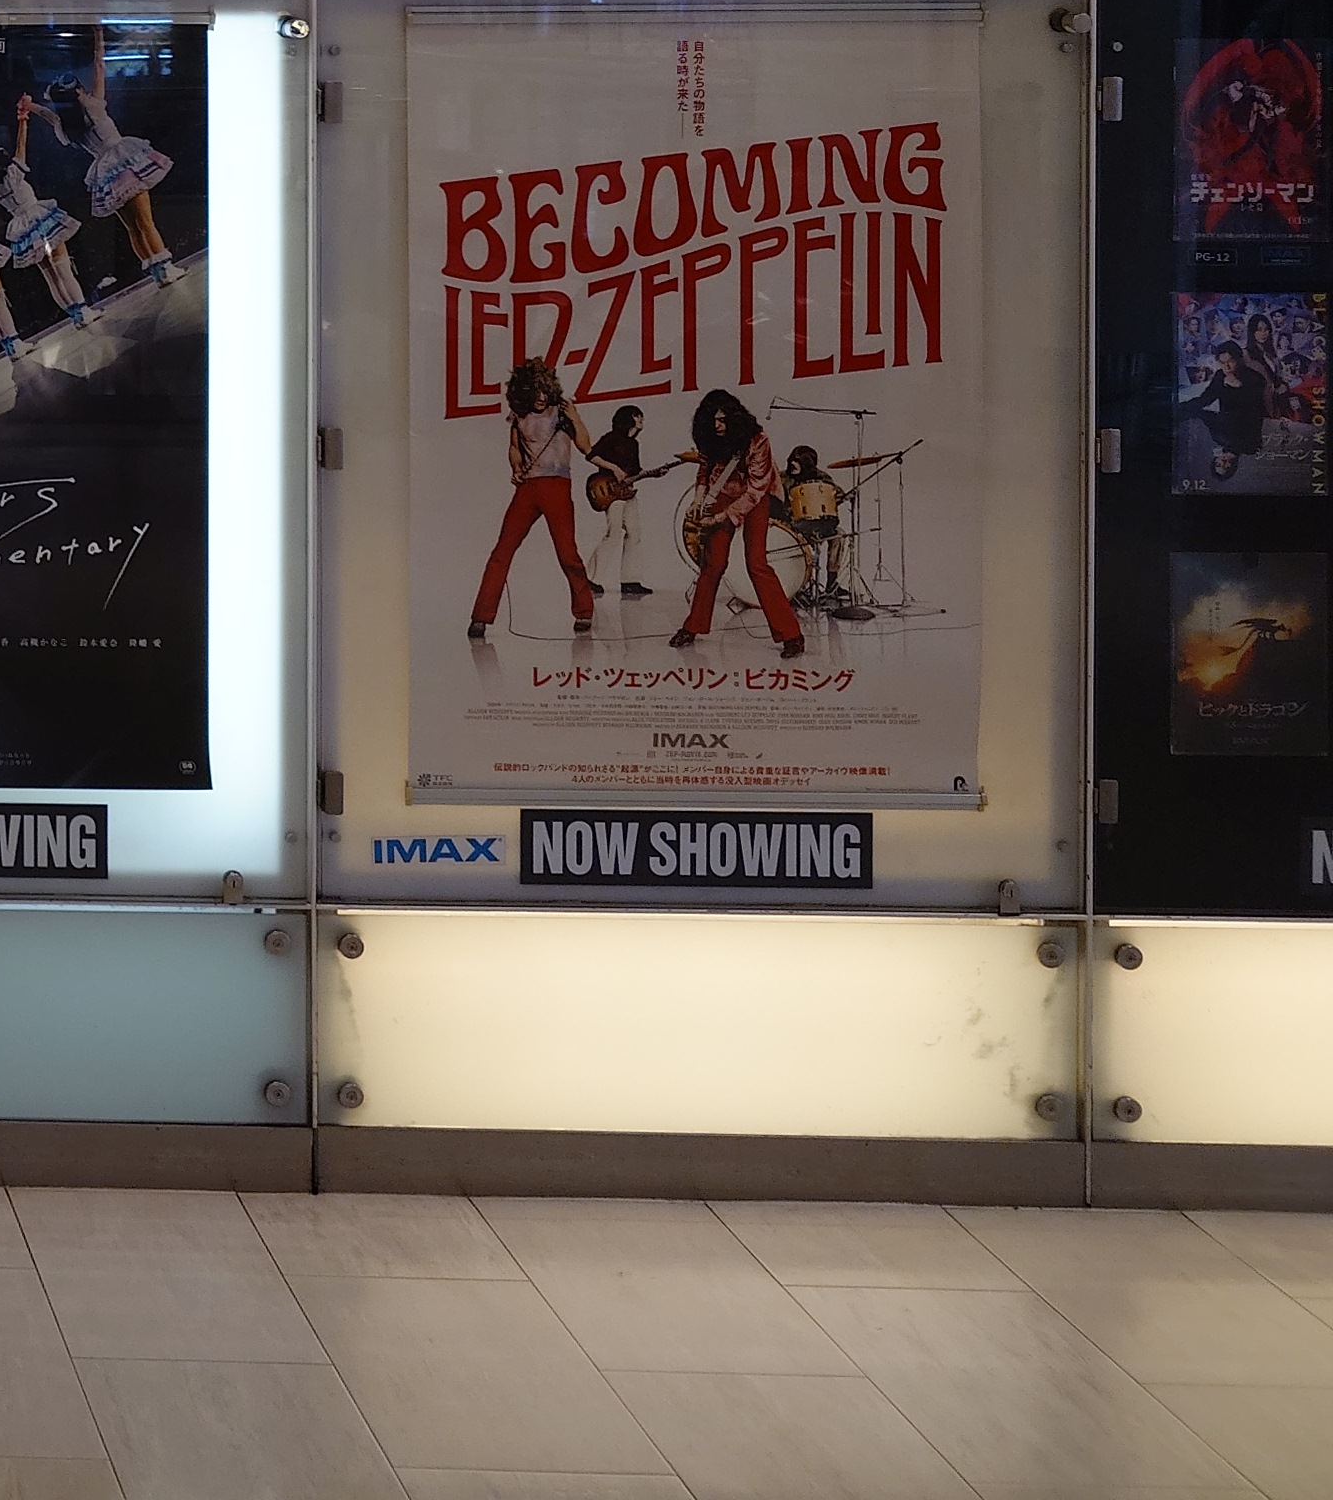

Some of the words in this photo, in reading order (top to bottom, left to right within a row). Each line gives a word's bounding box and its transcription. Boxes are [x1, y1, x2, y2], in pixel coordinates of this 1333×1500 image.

[693, 40, 705, 137] 自分たちの物語を
[439, 121, 947, 284] BECOMING
[1195, 252, 1231, 262] PG-12
[1311, 386, 1326, 495] SHOWMAN
[652, 732, 731, 749] IMAX
[374, 838, 500, 864] IMAX
[532, 821, 640, 875] NOW
[649, 823, 862, 879] SHOWING
